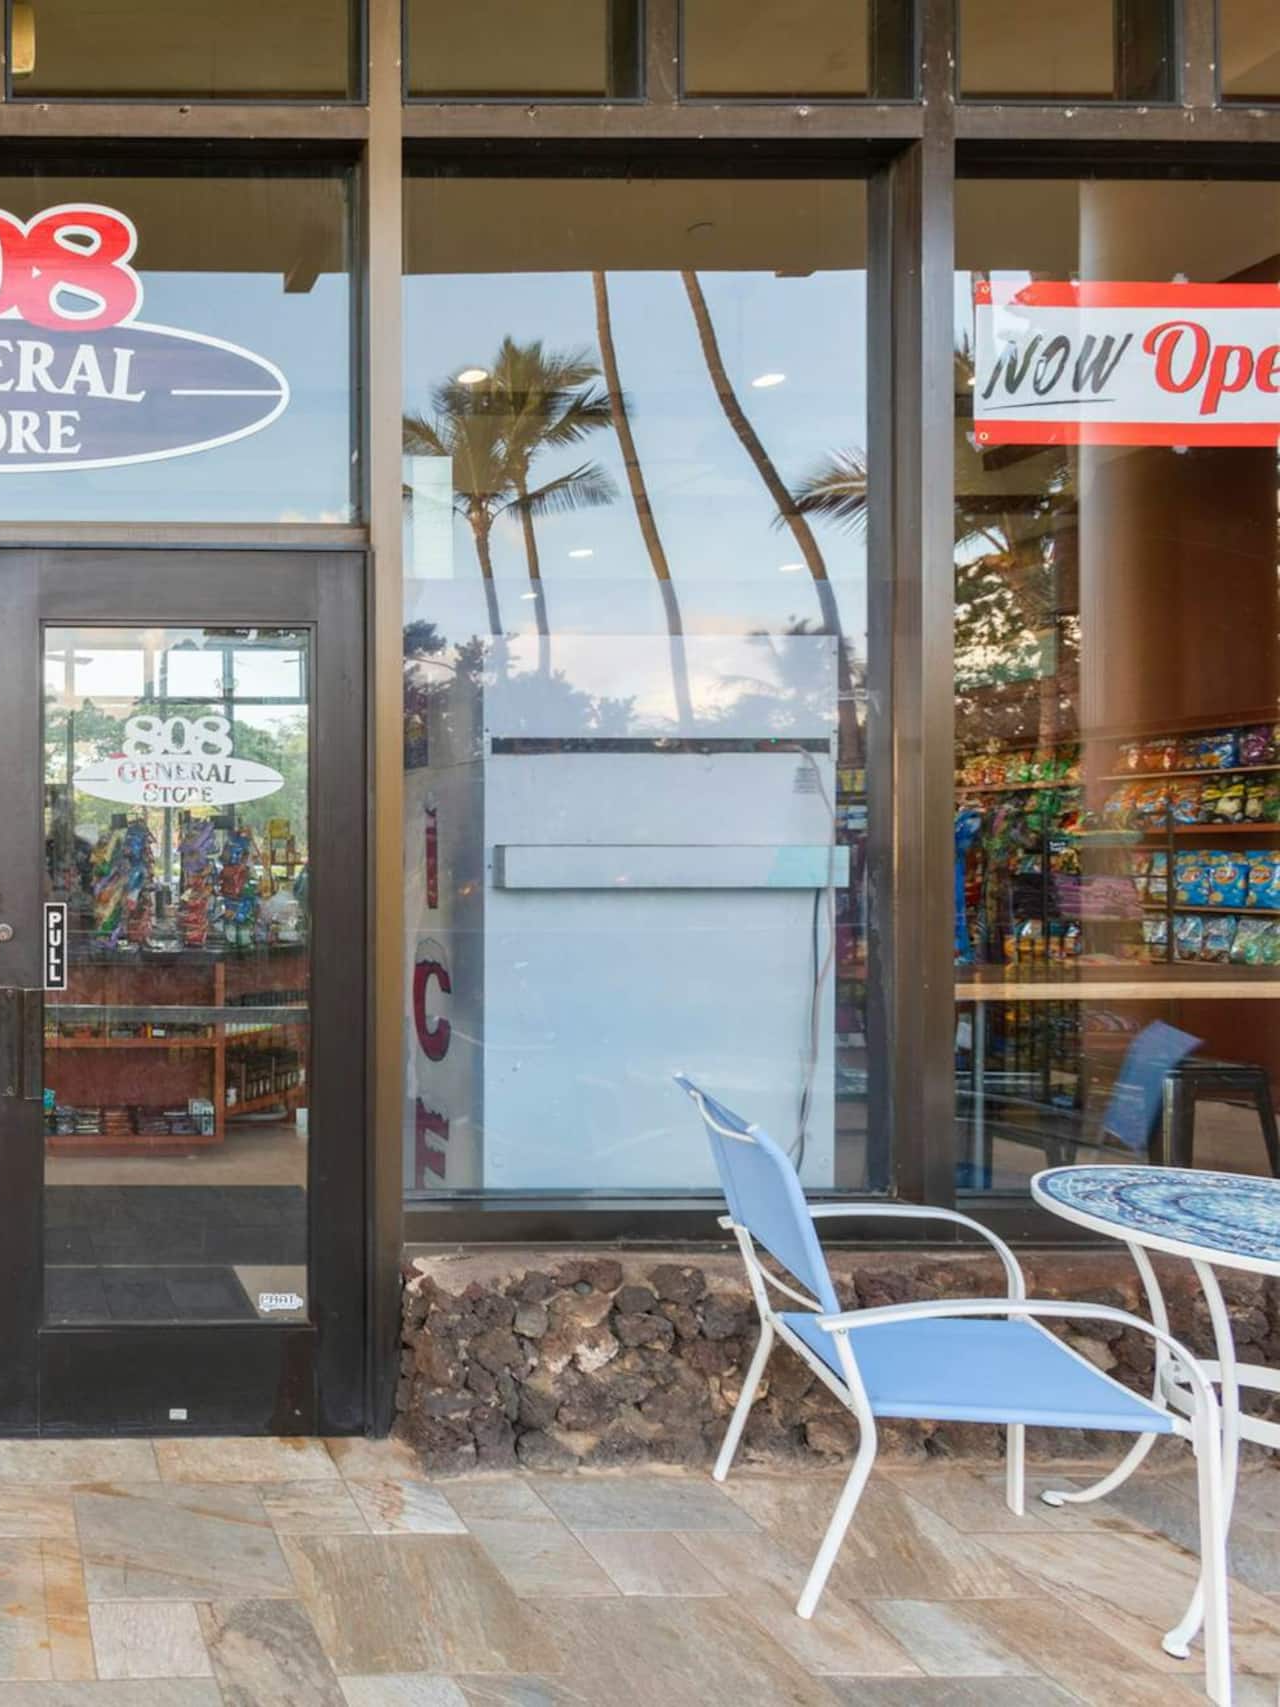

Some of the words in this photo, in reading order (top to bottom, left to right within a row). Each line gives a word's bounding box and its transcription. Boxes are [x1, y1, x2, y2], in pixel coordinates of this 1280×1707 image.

[981, 333, 1134, 399] NOW
[123, 715, 233, 758] 808
[117, 762, 236, 785] GENERAL
[48, 911, 62, 982] PULL
